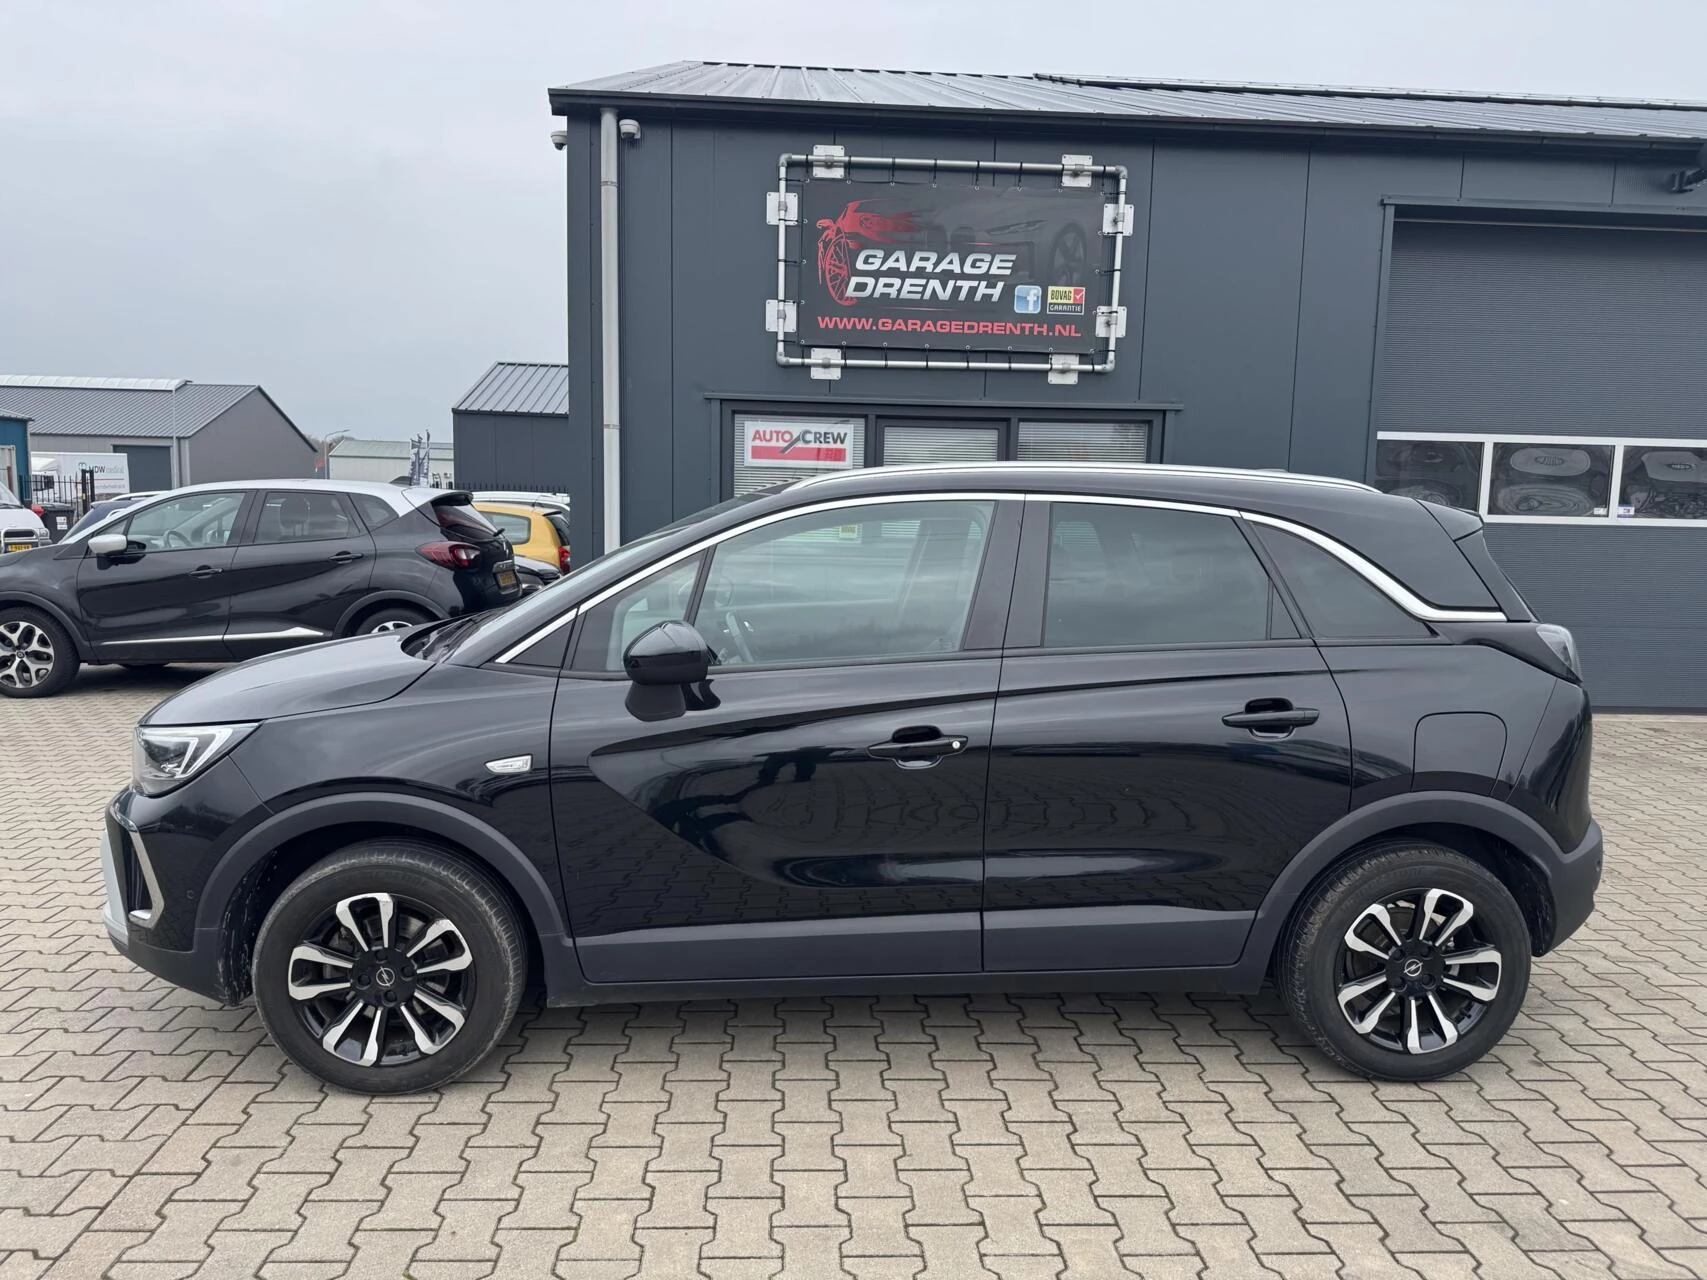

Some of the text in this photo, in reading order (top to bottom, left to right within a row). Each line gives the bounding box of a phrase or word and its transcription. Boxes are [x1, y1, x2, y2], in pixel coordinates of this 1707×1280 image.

[855, 249, 1017, 276] GARAGE
[845, 276, 1005, 302] DRENTH
[1050, 289, 1072, 301] BOVAG
[1049, 304, 1081, 312] GARANTIE
[817, 316, 1082, 337] WWW.GARAGEDRENTH.NL
[751, 429, 848, 445] AUTO CREW
